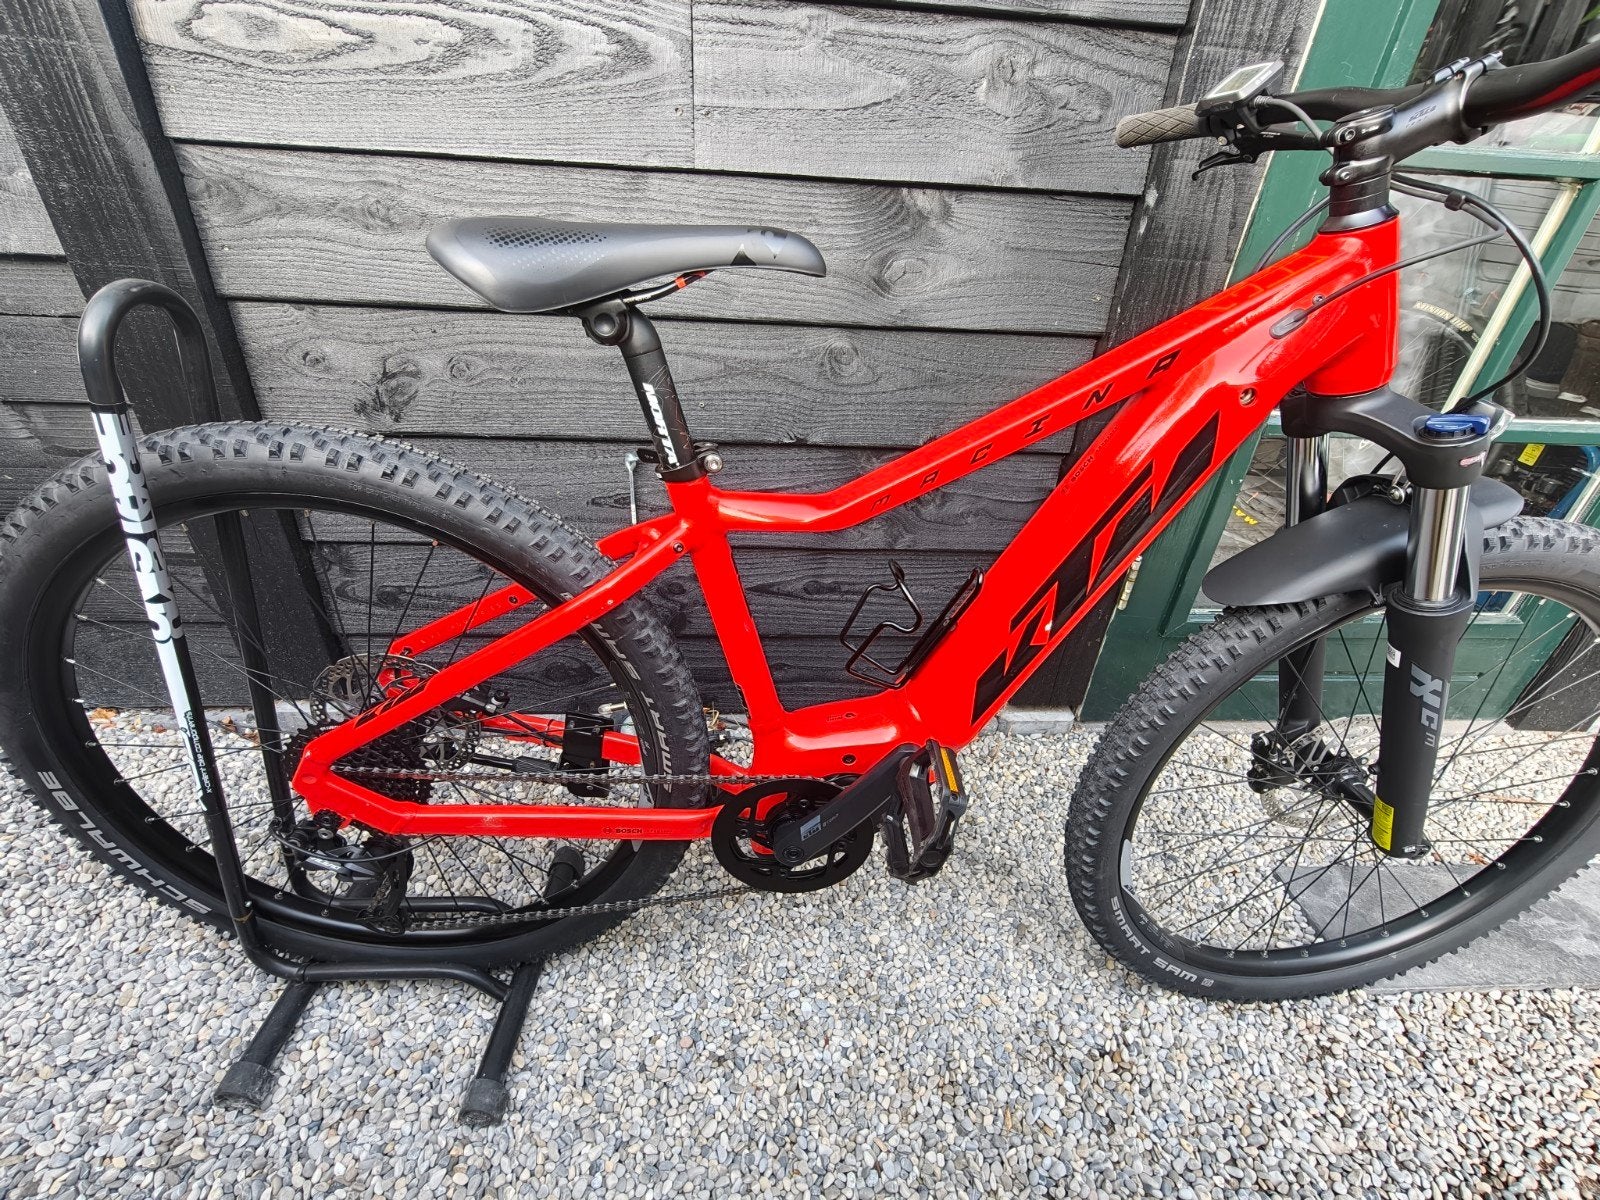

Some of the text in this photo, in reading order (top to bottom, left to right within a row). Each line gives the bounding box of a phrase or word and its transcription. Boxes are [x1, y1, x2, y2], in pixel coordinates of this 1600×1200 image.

[869, 349, 1182, 512] MACINA
[970, 410, 1221, 727] KTM
[36, 771, 213, 915] SCHWALBE
[1110, 895, 1151, 955] SMART
[1152, 956, 1198, 983] SAM
